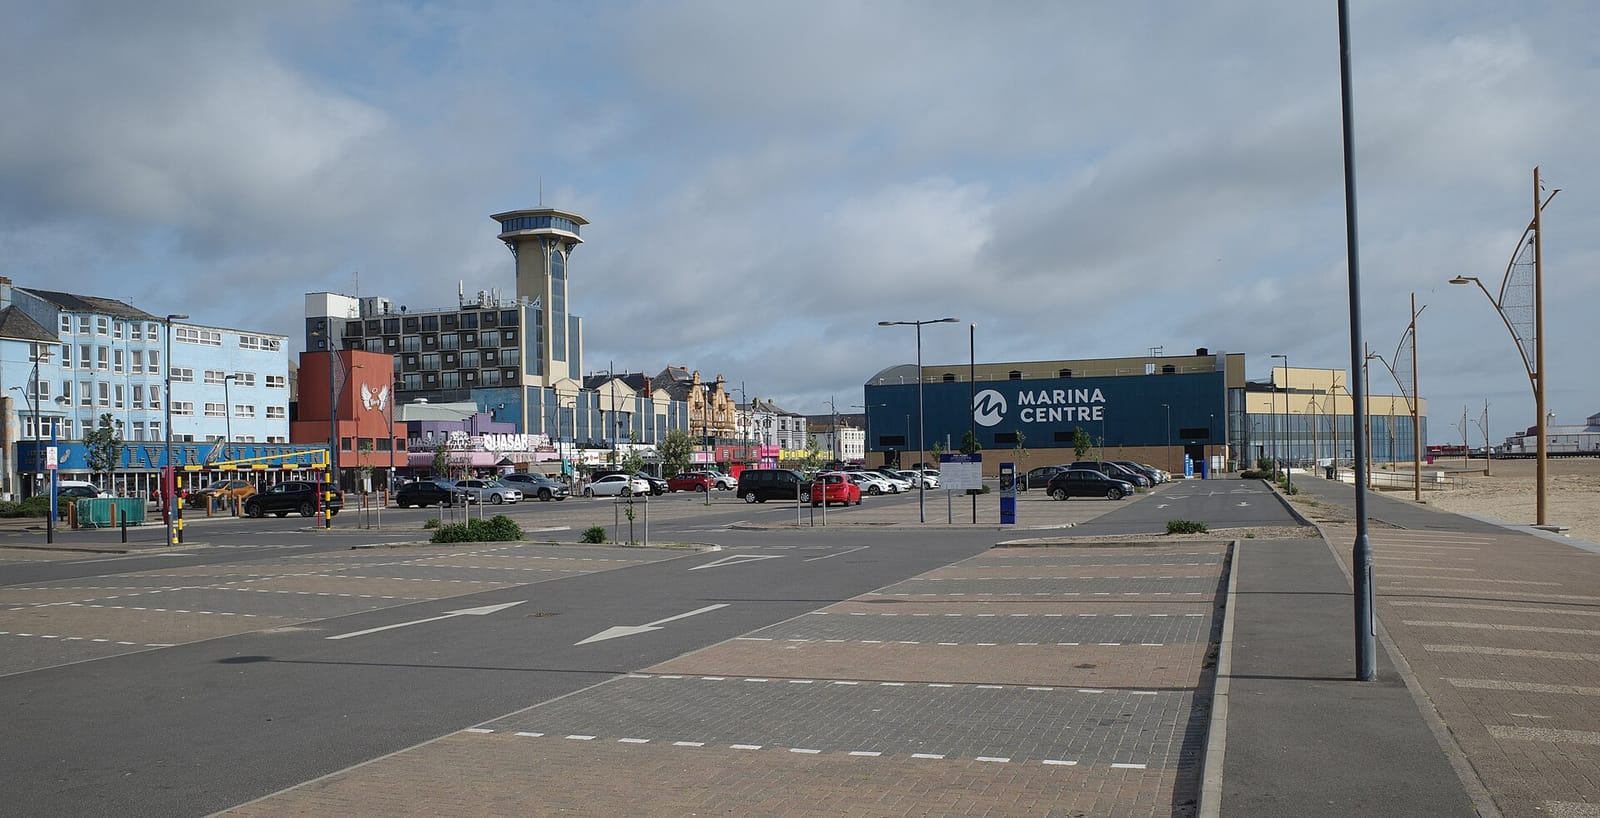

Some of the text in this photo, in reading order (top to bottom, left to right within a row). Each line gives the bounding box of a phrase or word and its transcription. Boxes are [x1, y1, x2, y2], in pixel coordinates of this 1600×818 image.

[1018, 388, 1105, 406] MARINA
[1020, 406, 1104, 422] CENTRE
[408, 436, 445, 448] UASAR
[483, 433, 528, 451] QUASAR
[112, 445, 201, 468] ILVER
